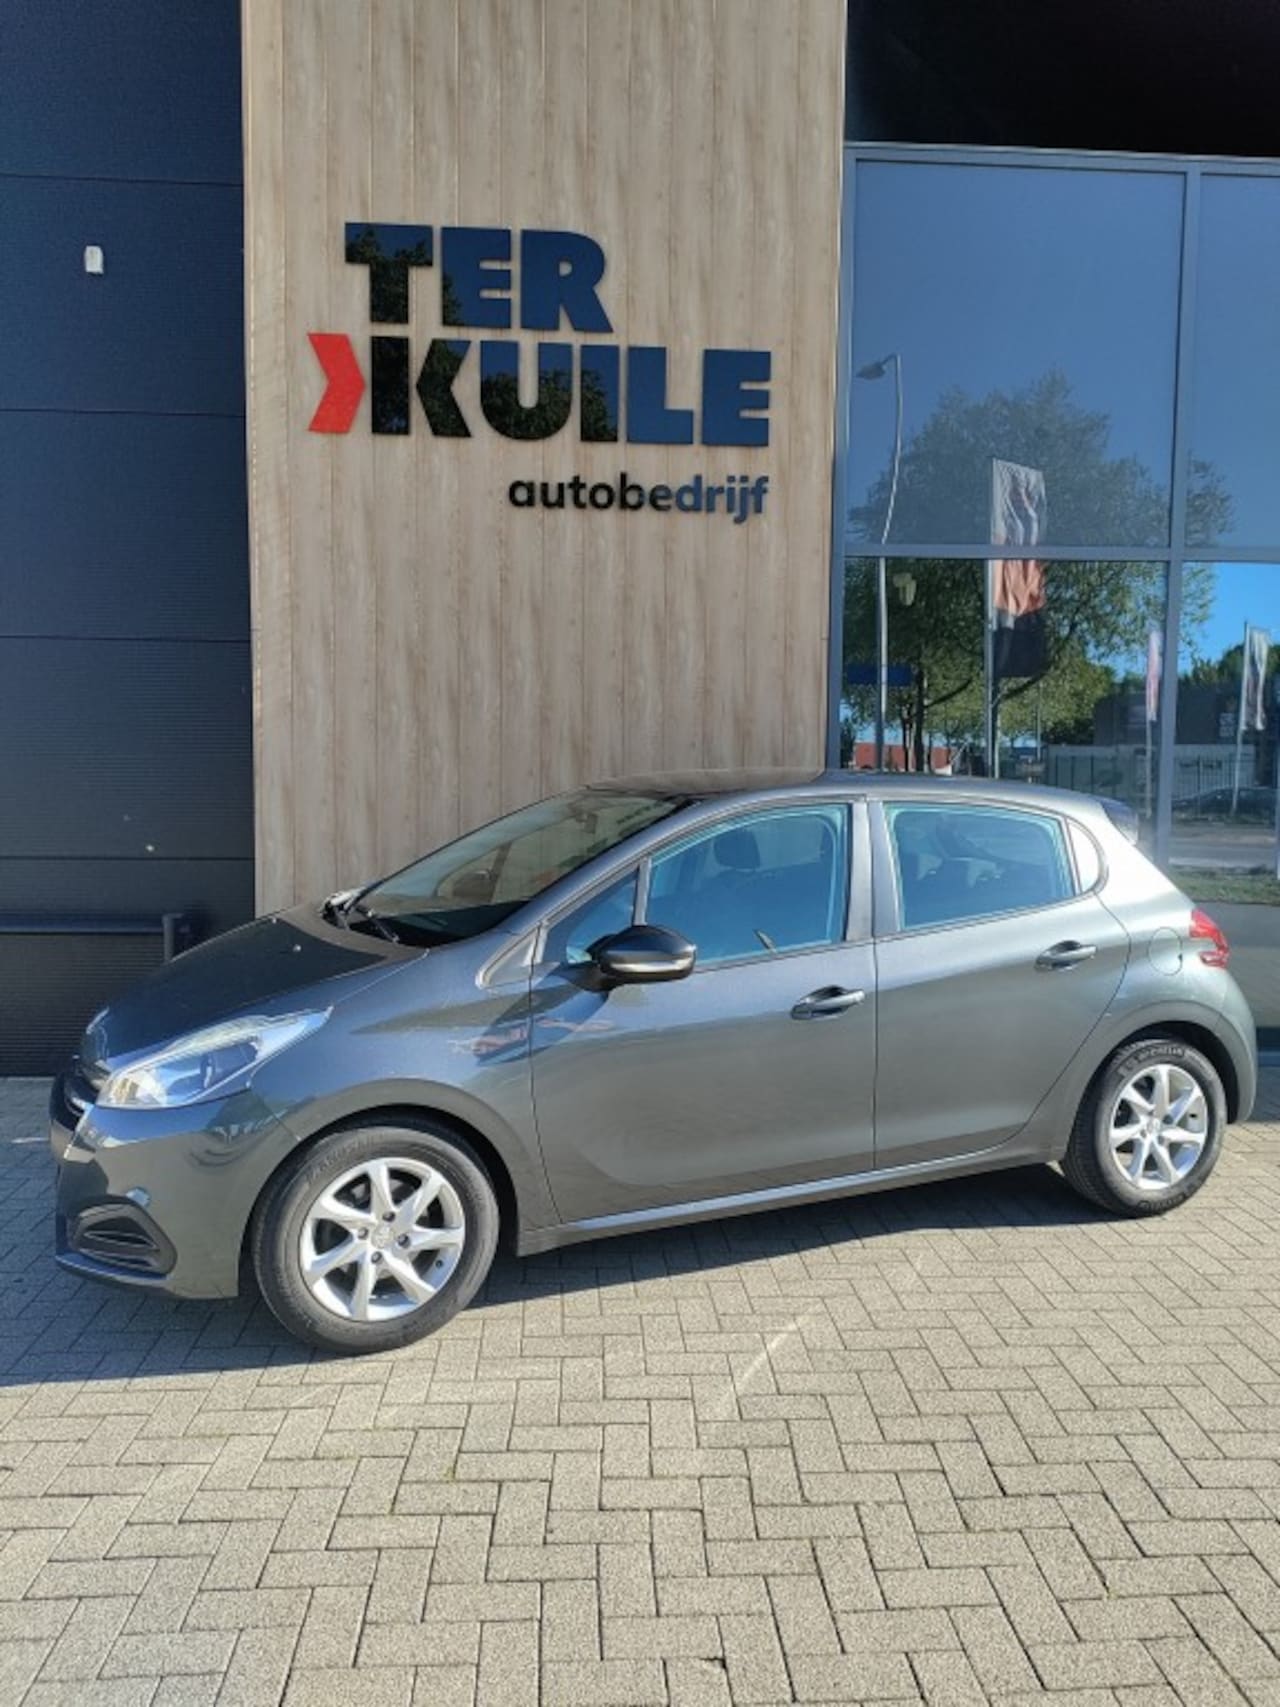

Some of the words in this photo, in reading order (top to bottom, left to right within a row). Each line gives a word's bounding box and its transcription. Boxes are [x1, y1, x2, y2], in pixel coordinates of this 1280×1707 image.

[345, 222, 613, 333] TER
[371, 335, 771, 447] KUILE
[508, 472, 769, 524] autobedrijf
